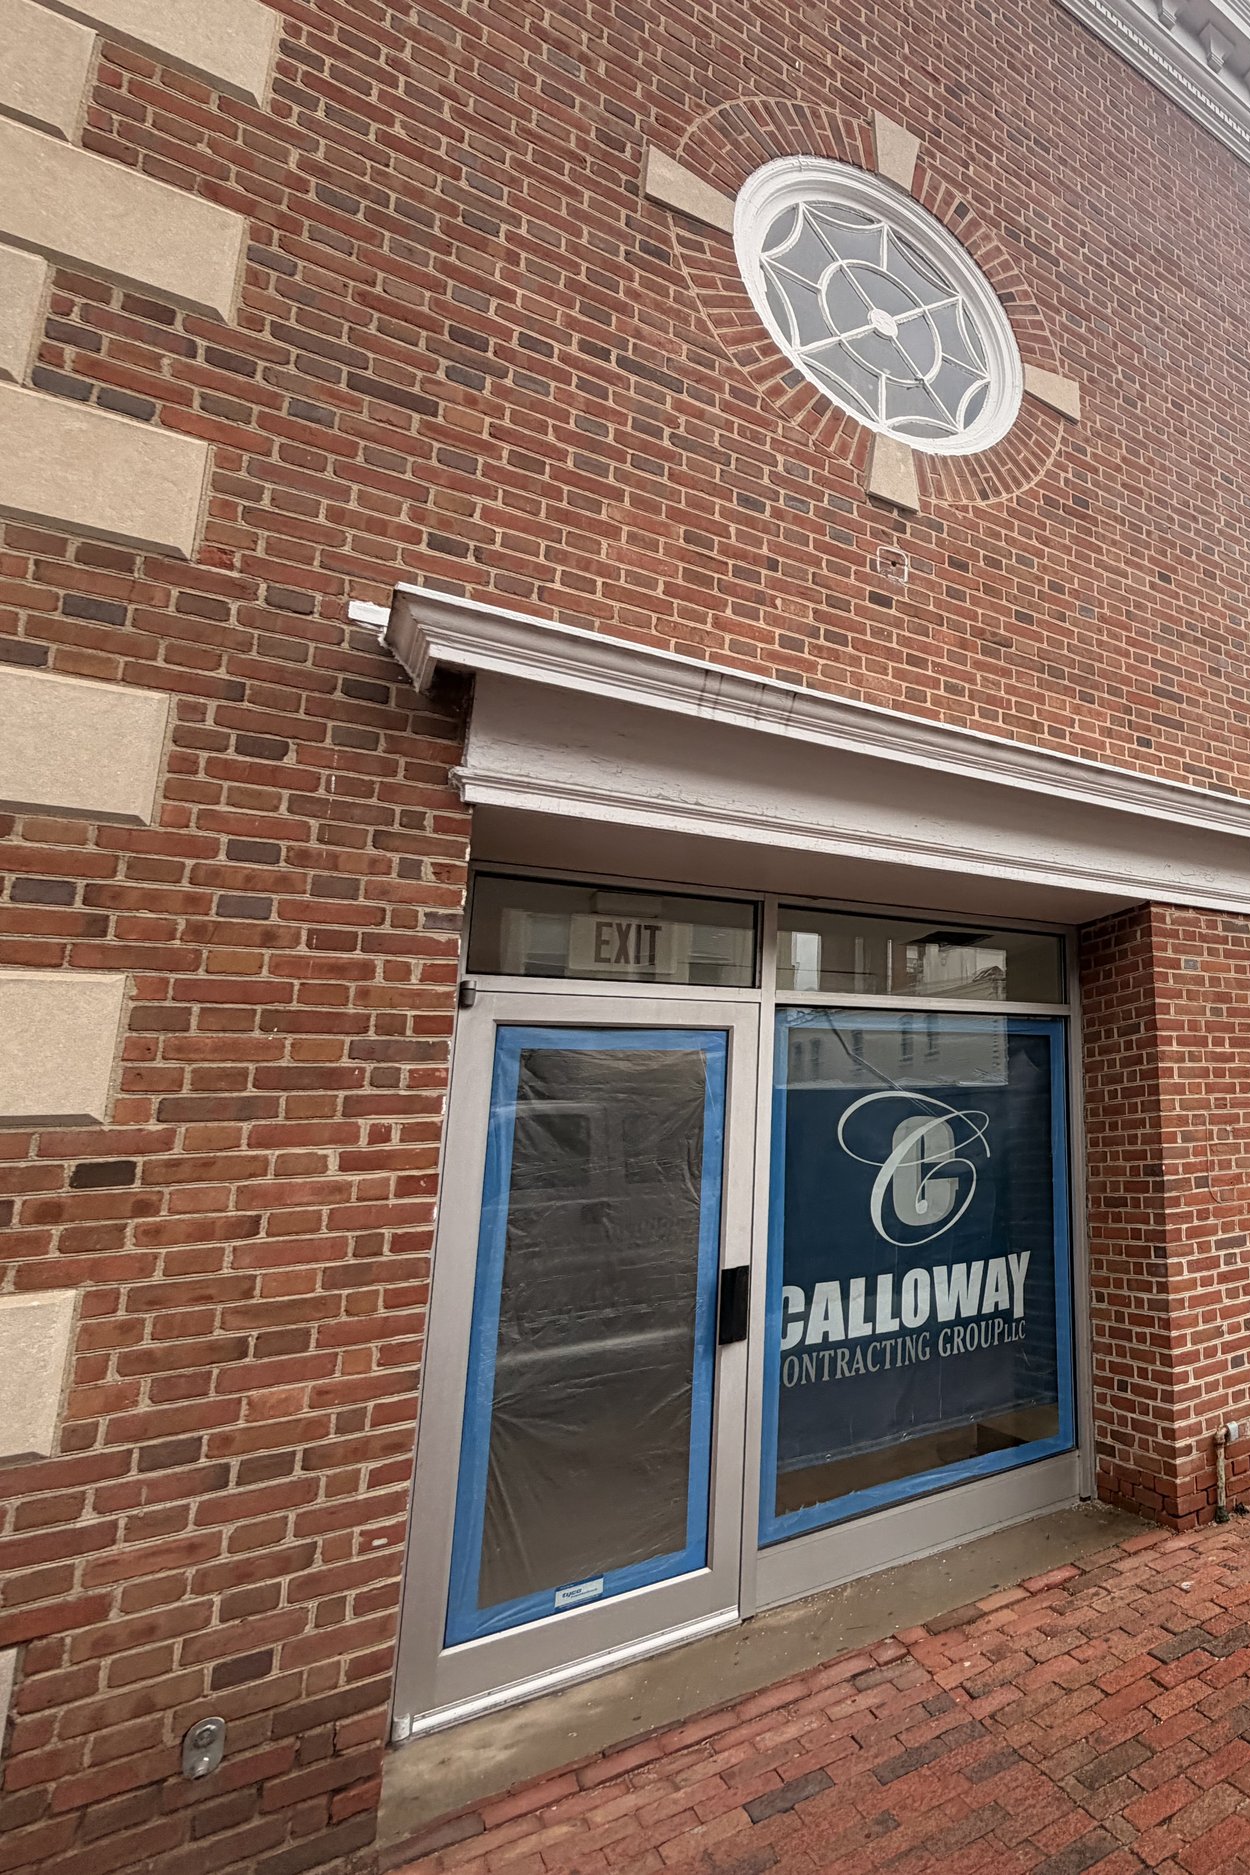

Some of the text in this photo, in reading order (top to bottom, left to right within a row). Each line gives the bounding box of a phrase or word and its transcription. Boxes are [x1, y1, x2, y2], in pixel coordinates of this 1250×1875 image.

[594, 921, 662, 966] EXIT
[780, 1250, 1031, 1351] CALLOWAY
[782, 1331, 930, 1388] ONTRACTING
